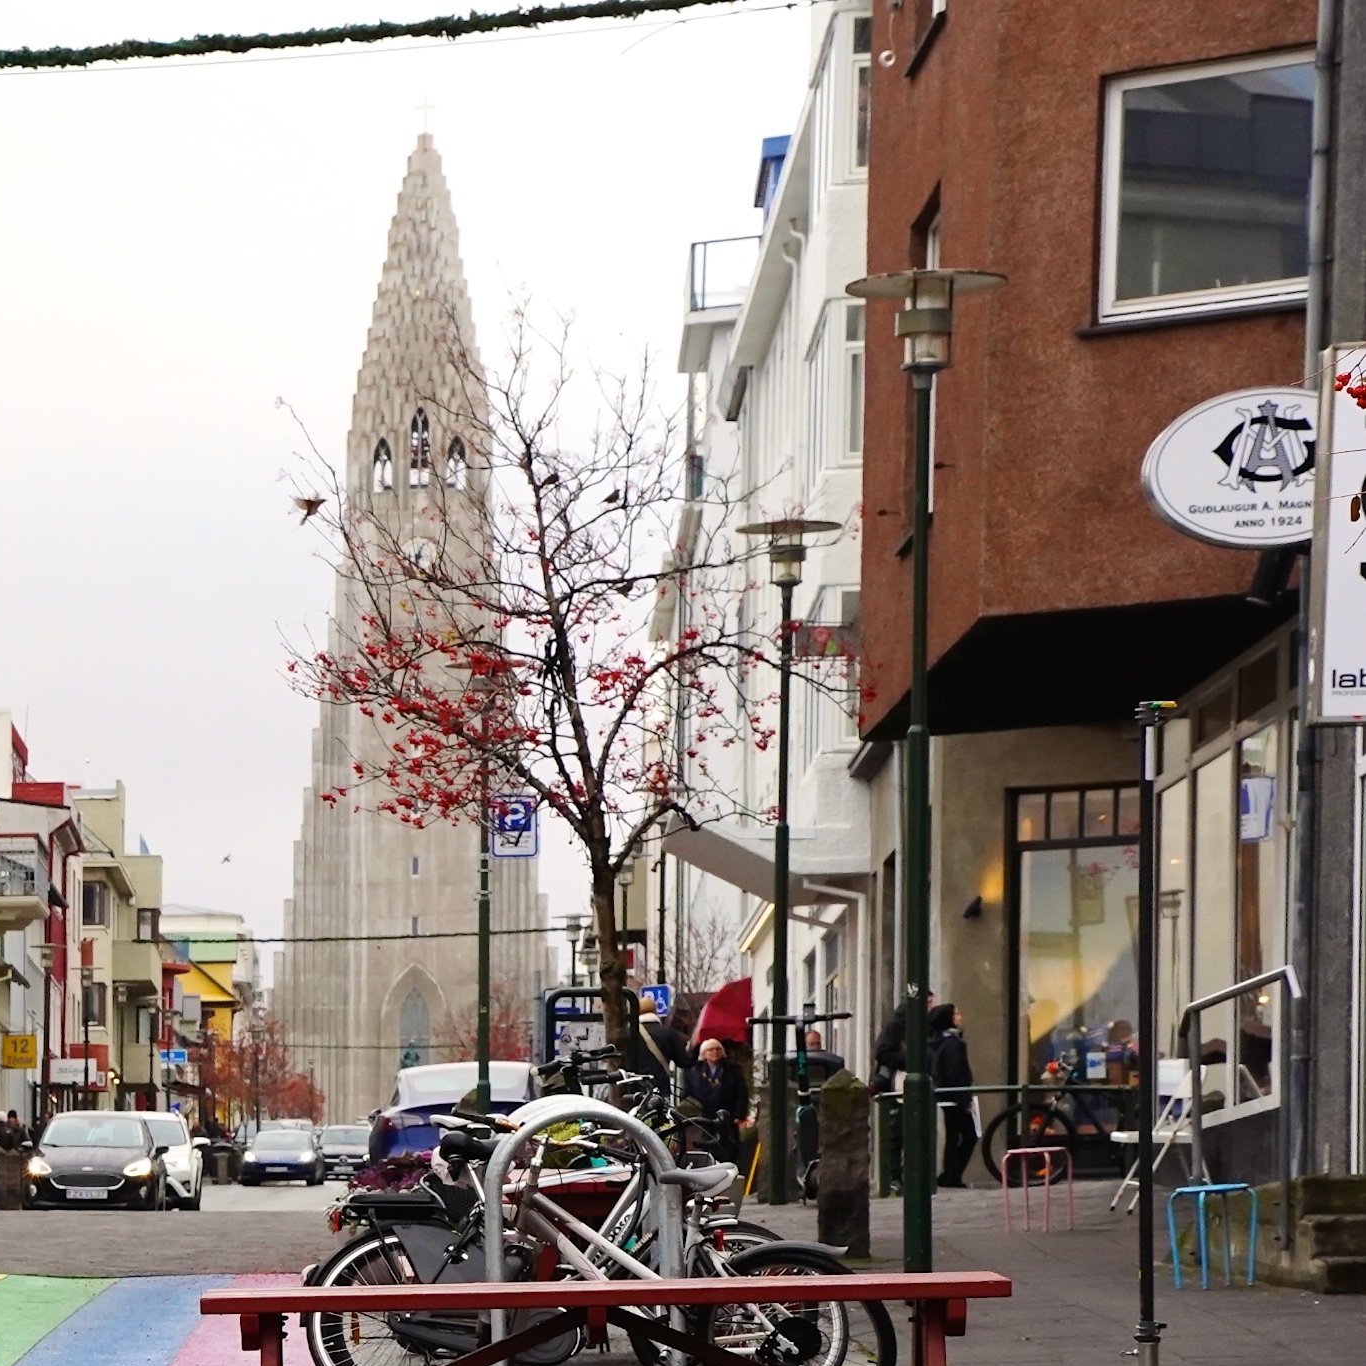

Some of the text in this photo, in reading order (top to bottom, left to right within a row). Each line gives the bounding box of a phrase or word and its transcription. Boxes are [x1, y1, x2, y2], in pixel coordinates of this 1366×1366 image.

[1234, 515, 1303, 529] ANNO 1924
[11, 1038, 30, 1054] 12
